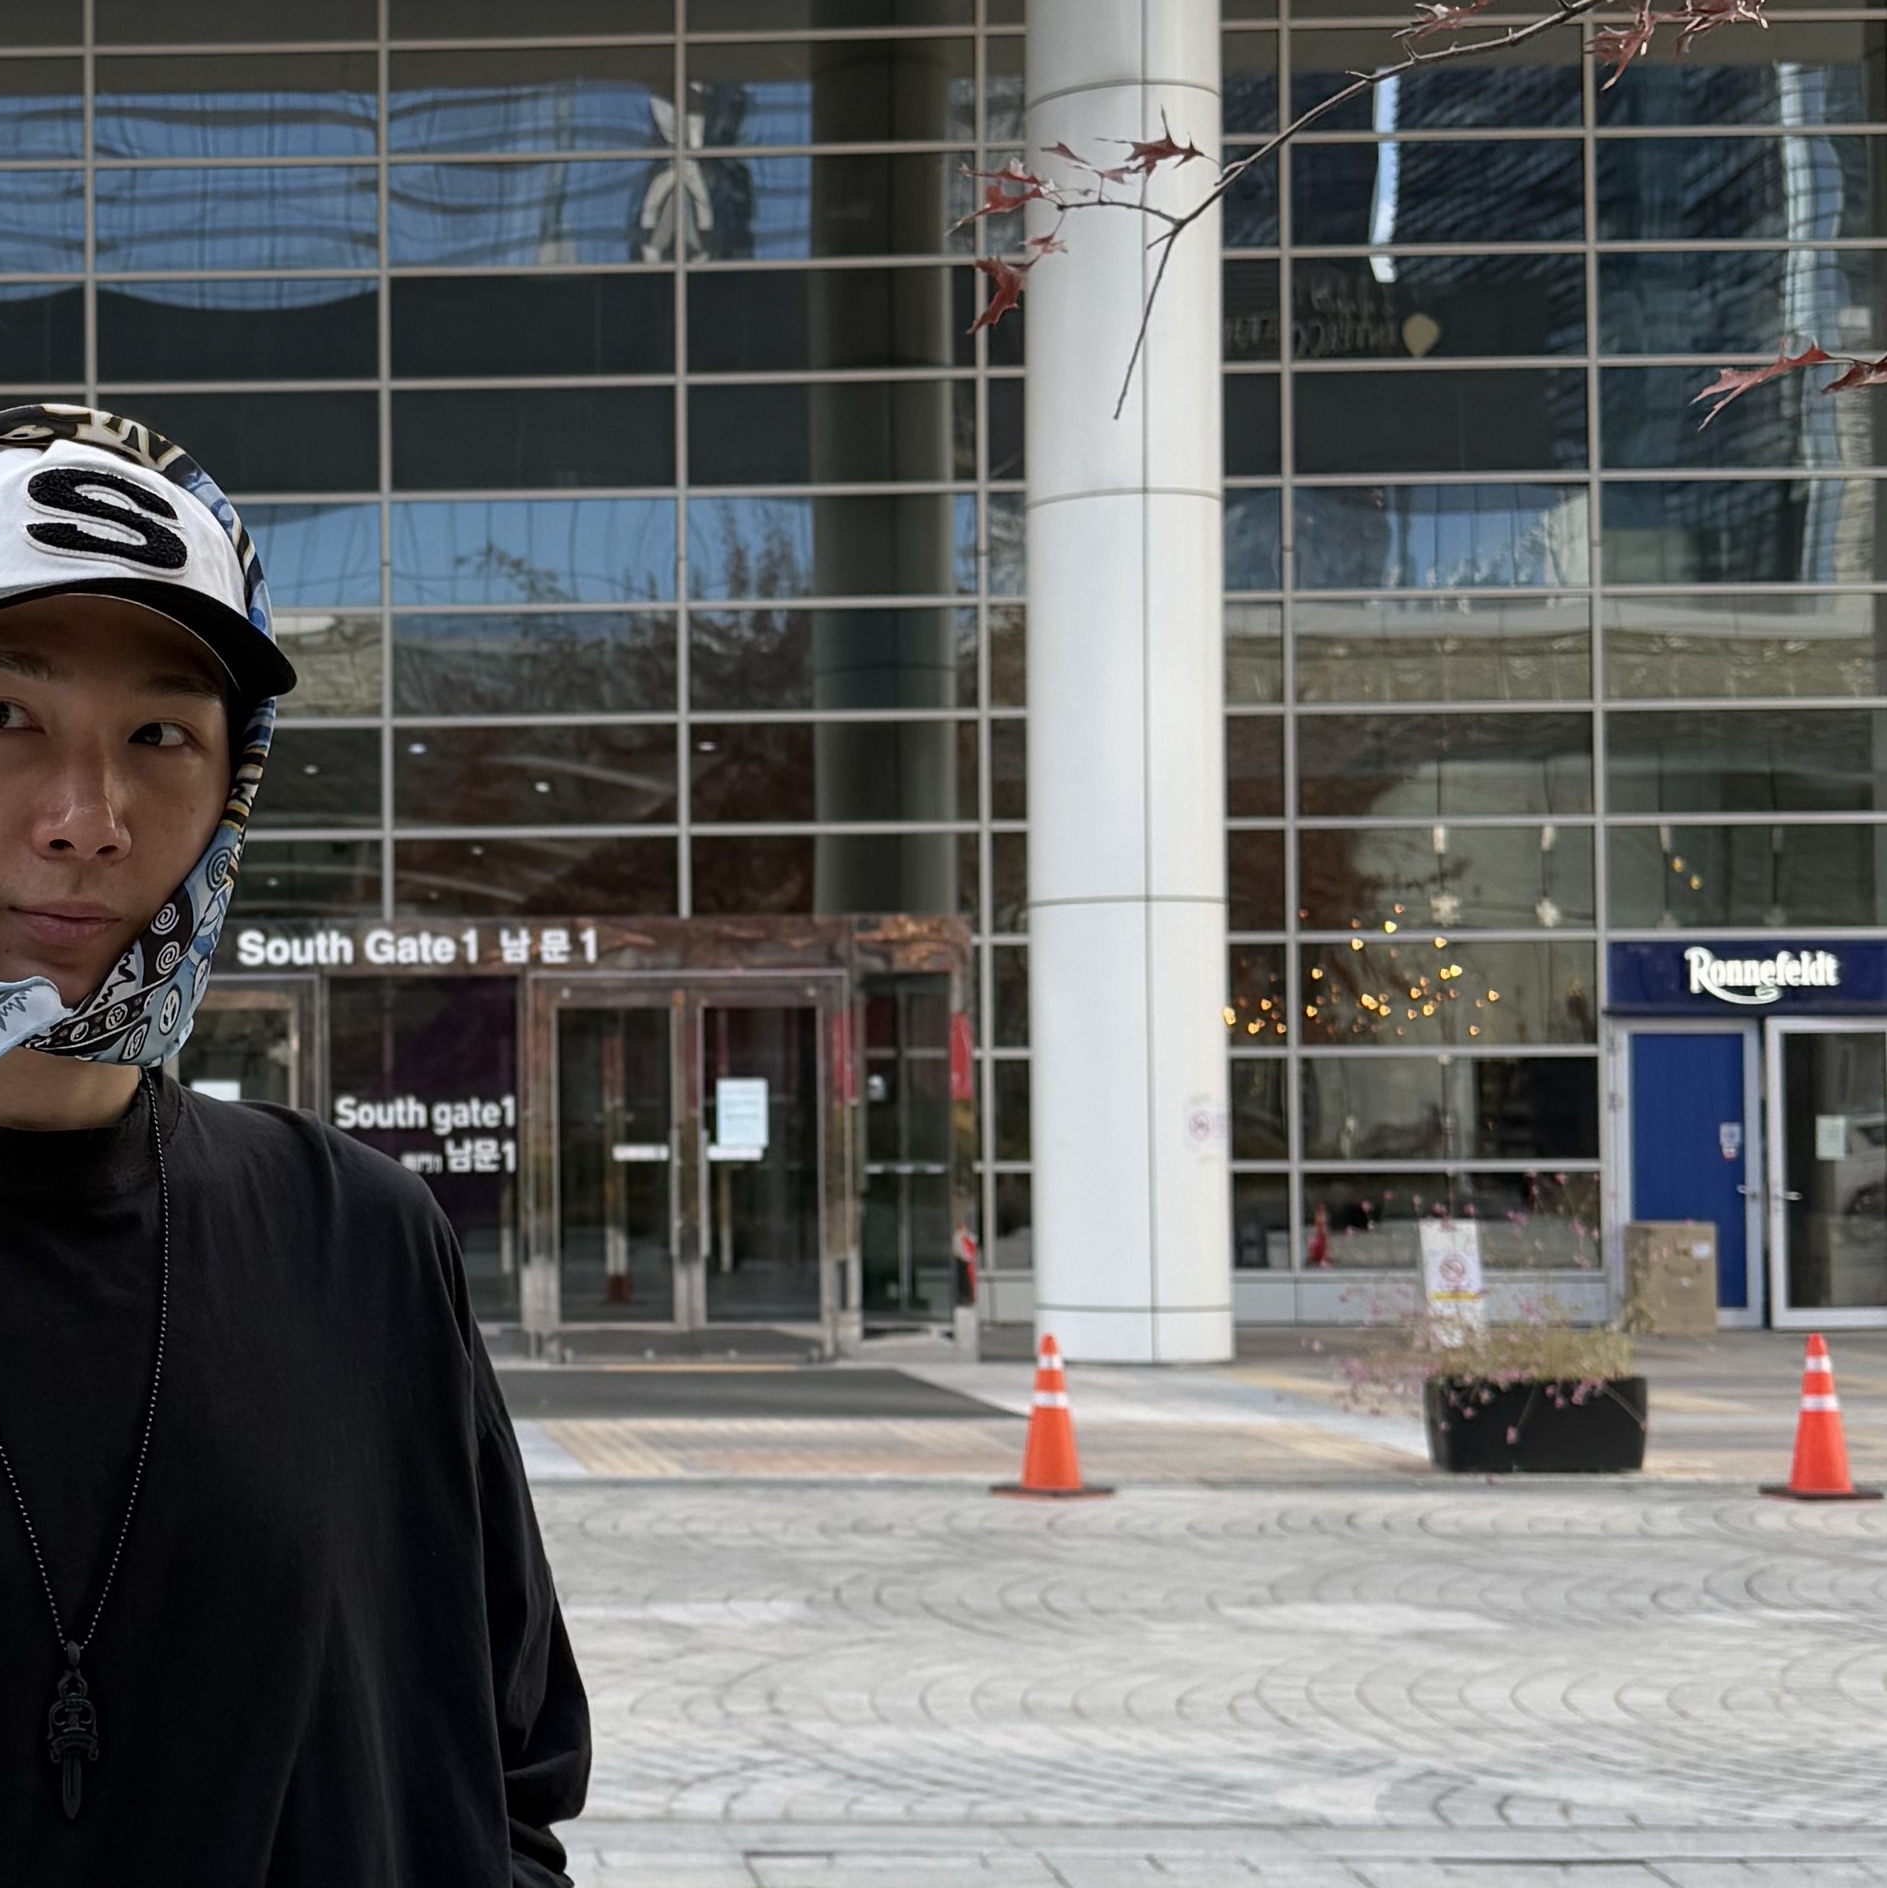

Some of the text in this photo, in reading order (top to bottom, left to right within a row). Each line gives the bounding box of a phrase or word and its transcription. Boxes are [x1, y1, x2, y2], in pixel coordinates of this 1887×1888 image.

[26, 467, 189, 570] S
[237, 929, 354, 965] South
[1684, 946, 1841, 1005] Ronnefeldt
[334, 1095, 428, 1129] South
